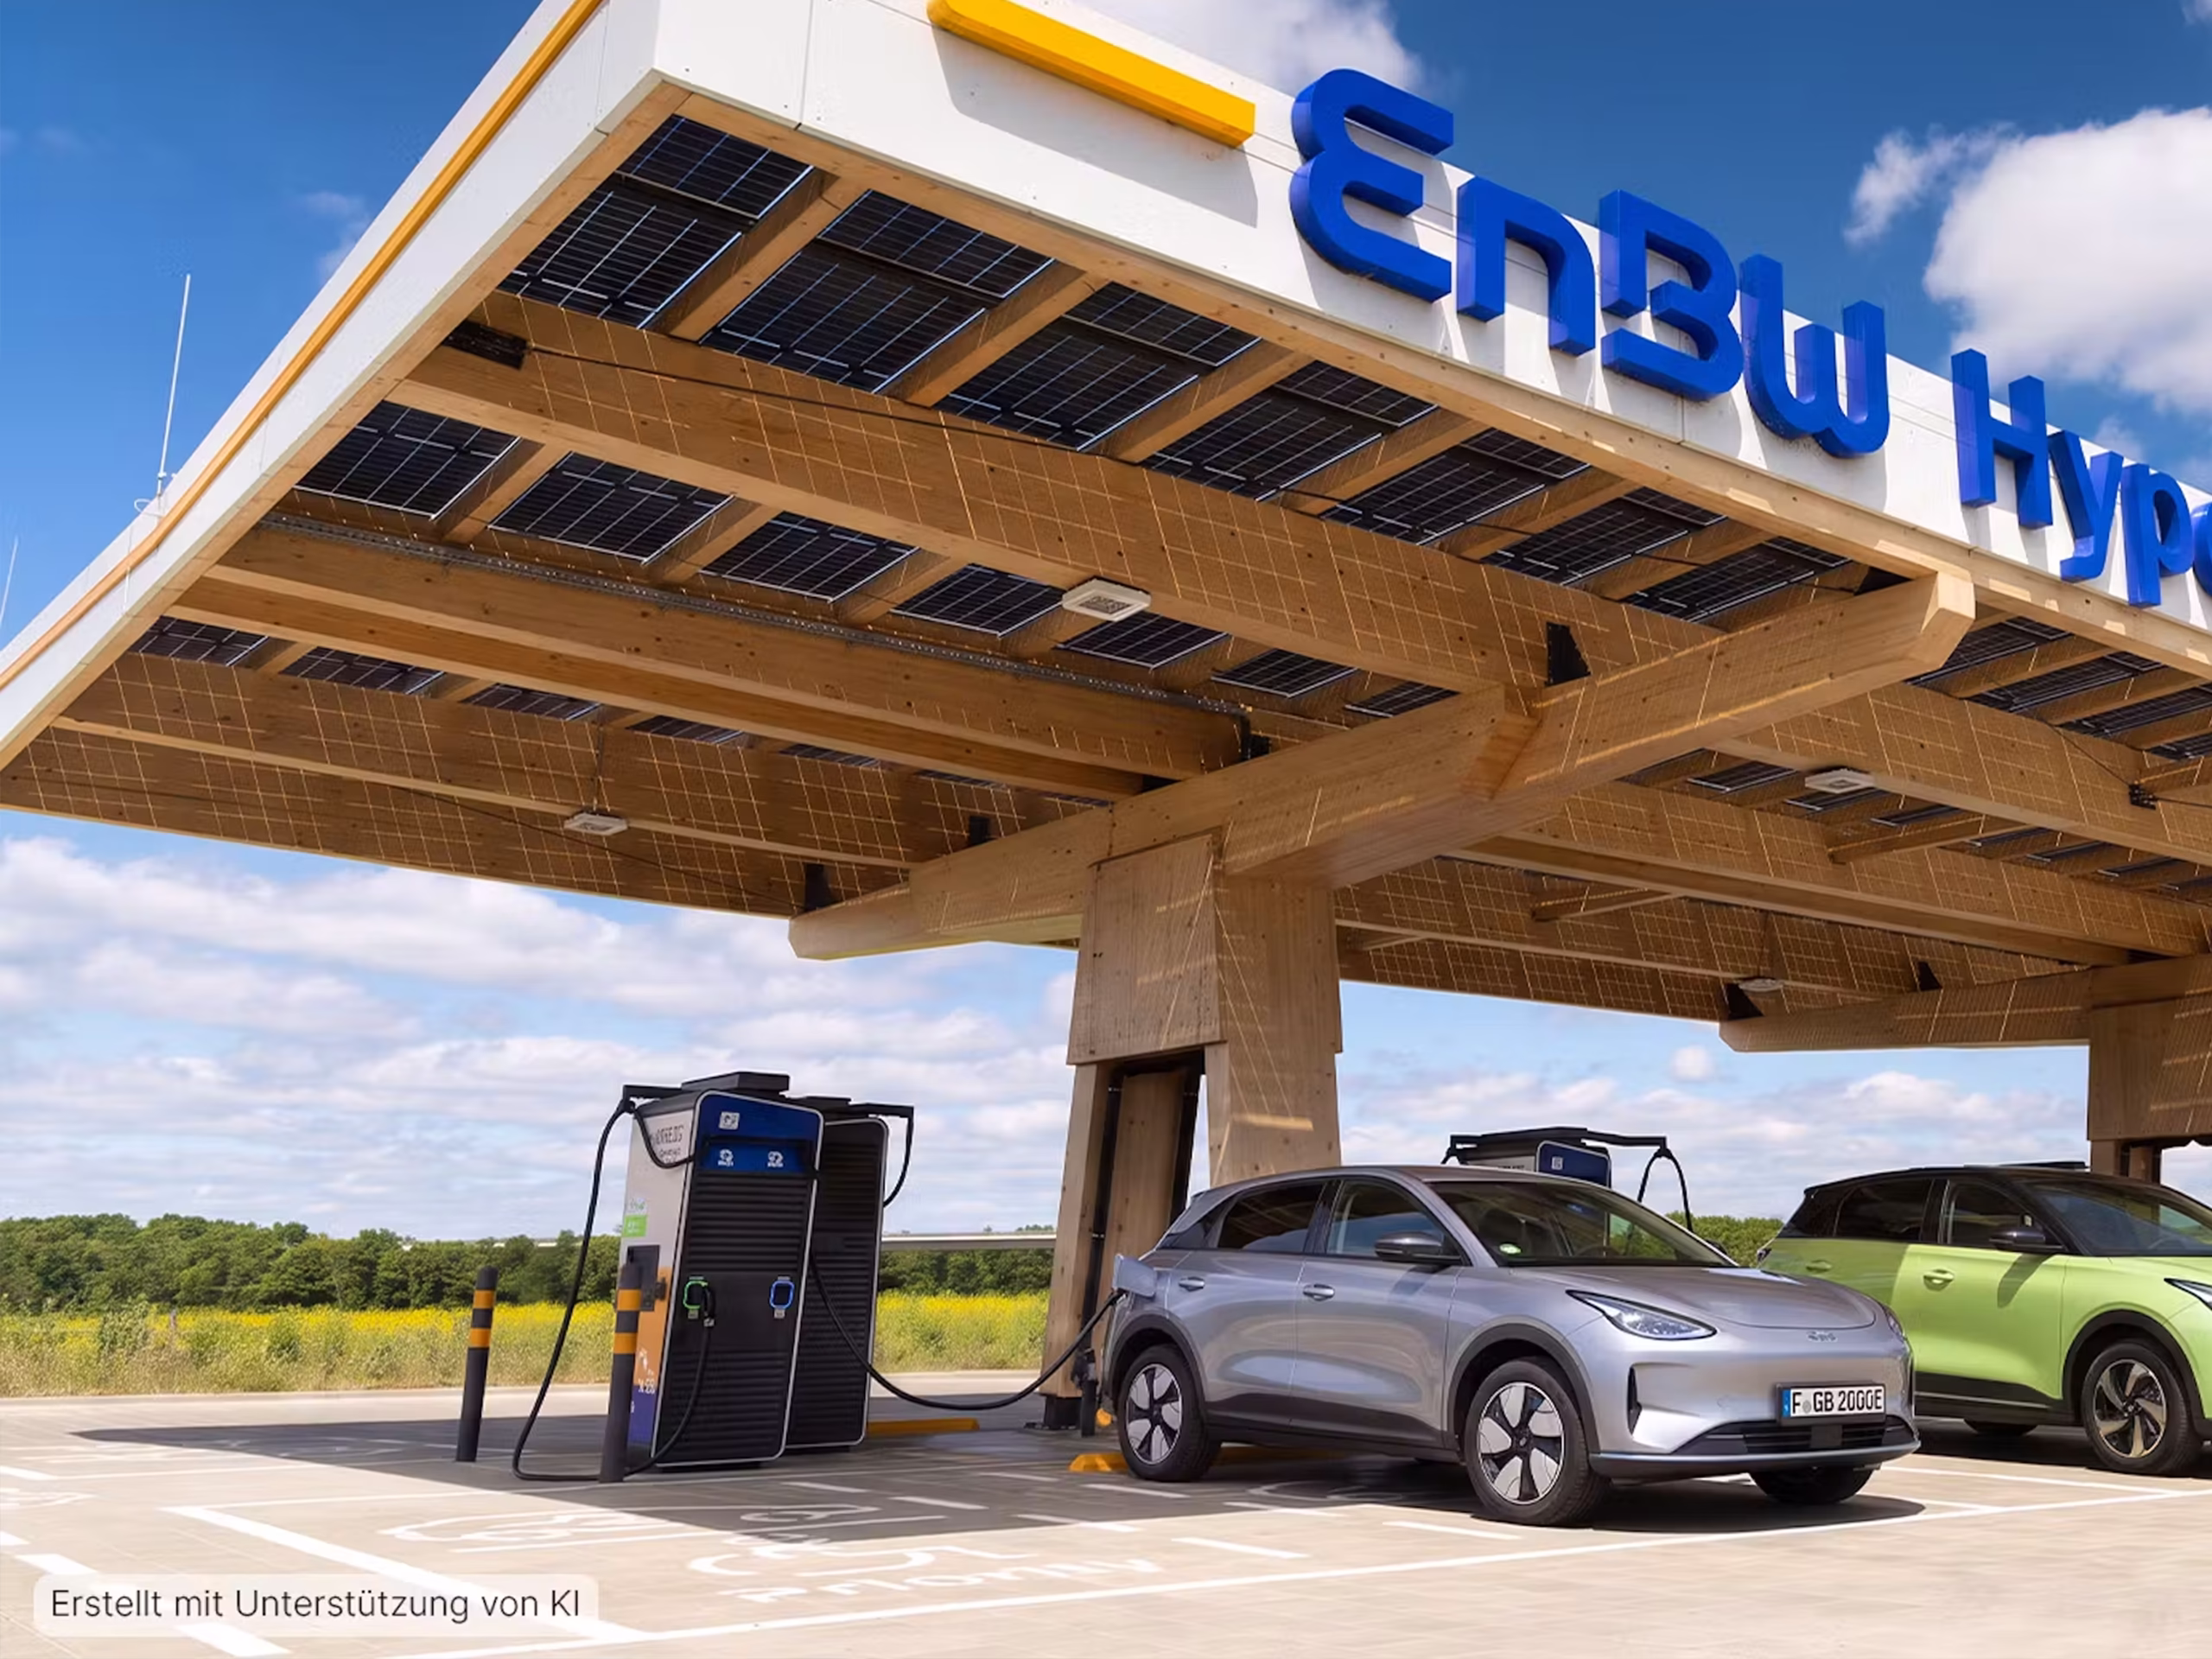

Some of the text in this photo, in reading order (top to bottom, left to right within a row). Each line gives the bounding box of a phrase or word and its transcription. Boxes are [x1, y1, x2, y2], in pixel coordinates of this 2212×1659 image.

[1289, 69, 1890, 457] EnBW
[1792, 1389, 1882, 1414] F GB 2000E
